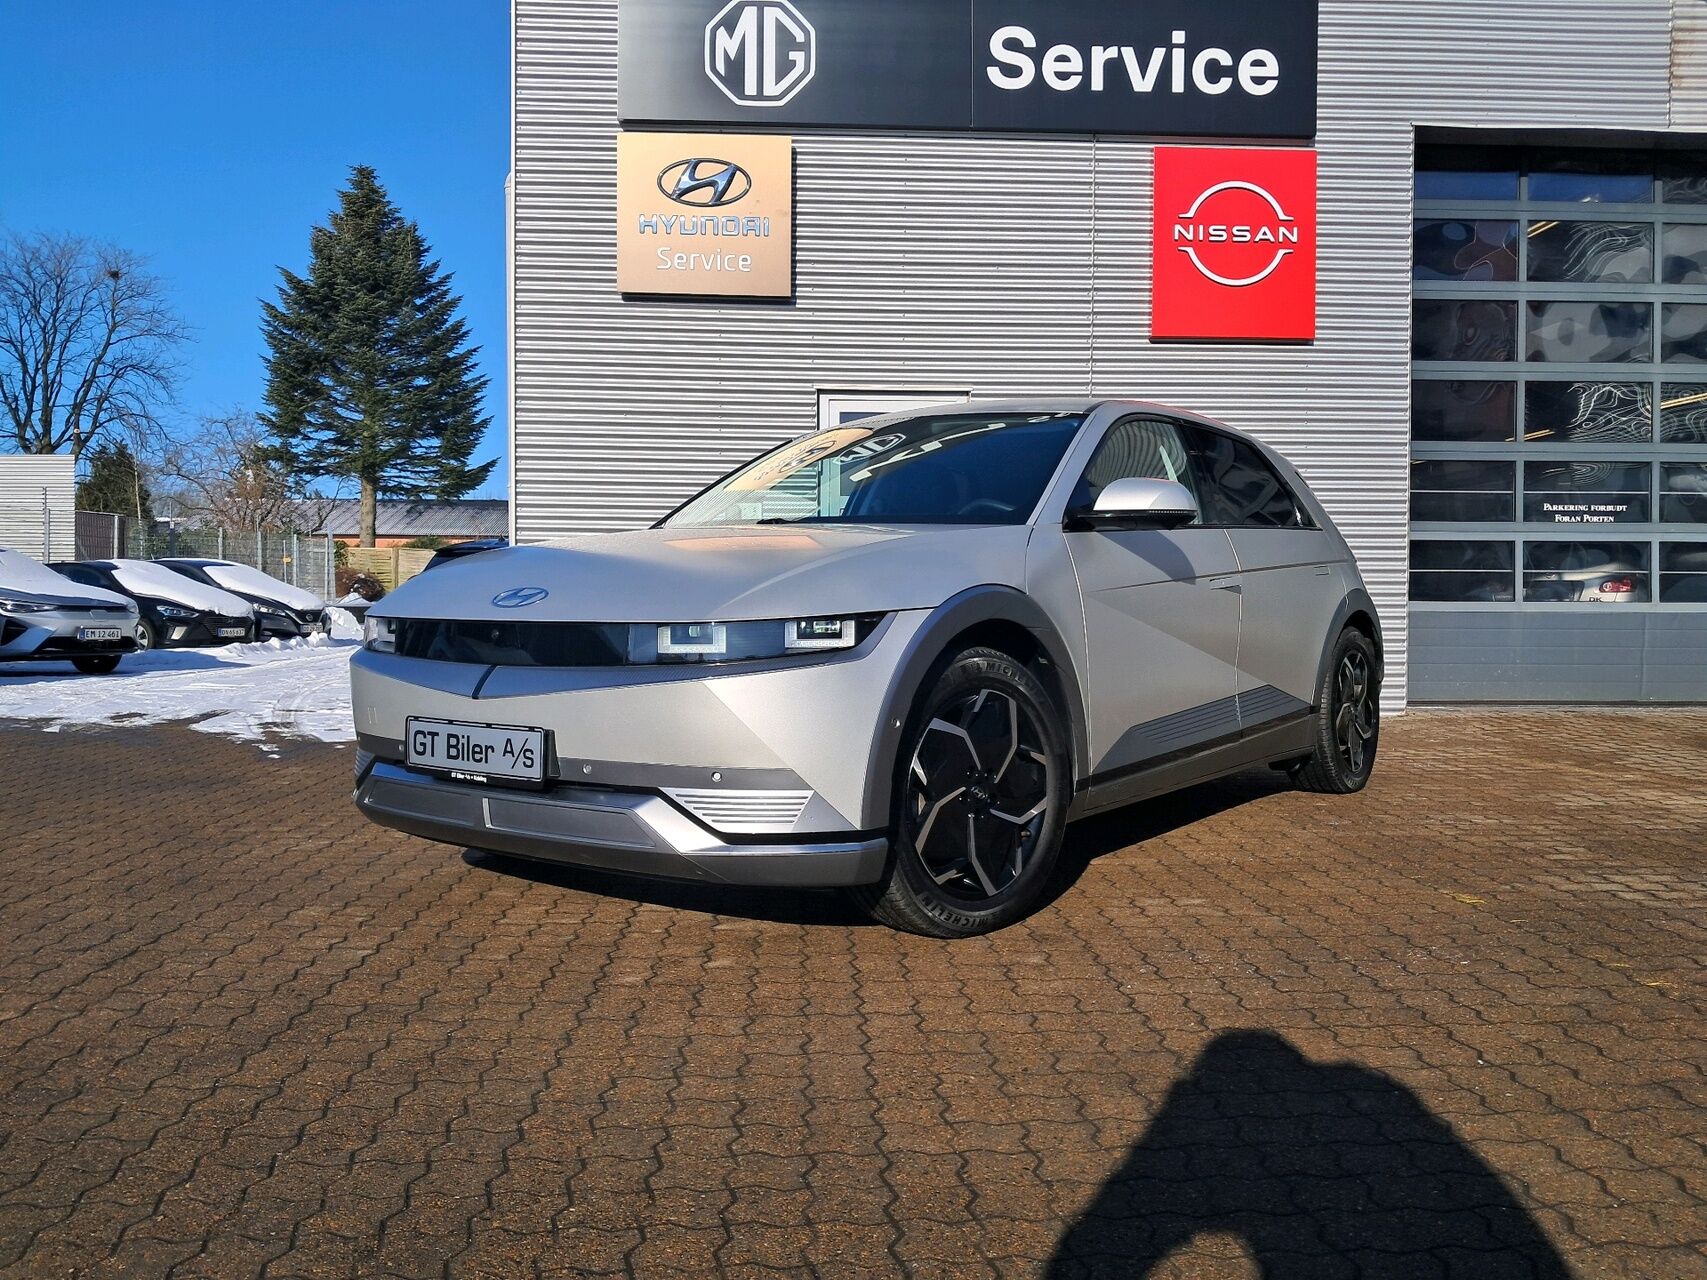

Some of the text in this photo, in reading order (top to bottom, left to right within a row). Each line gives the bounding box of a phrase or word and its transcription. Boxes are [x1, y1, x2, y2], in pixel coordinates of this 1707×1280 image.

[716, 6, 1279, 96] MG Service
[639, 214, 769, 237] HYUNDAI
[1174, 224, 1298, 243] NISSAN
[656, 247, 752, 271] Service
[413, 730, 439, 757] GT
[447, 733, 495, 764] Biler
